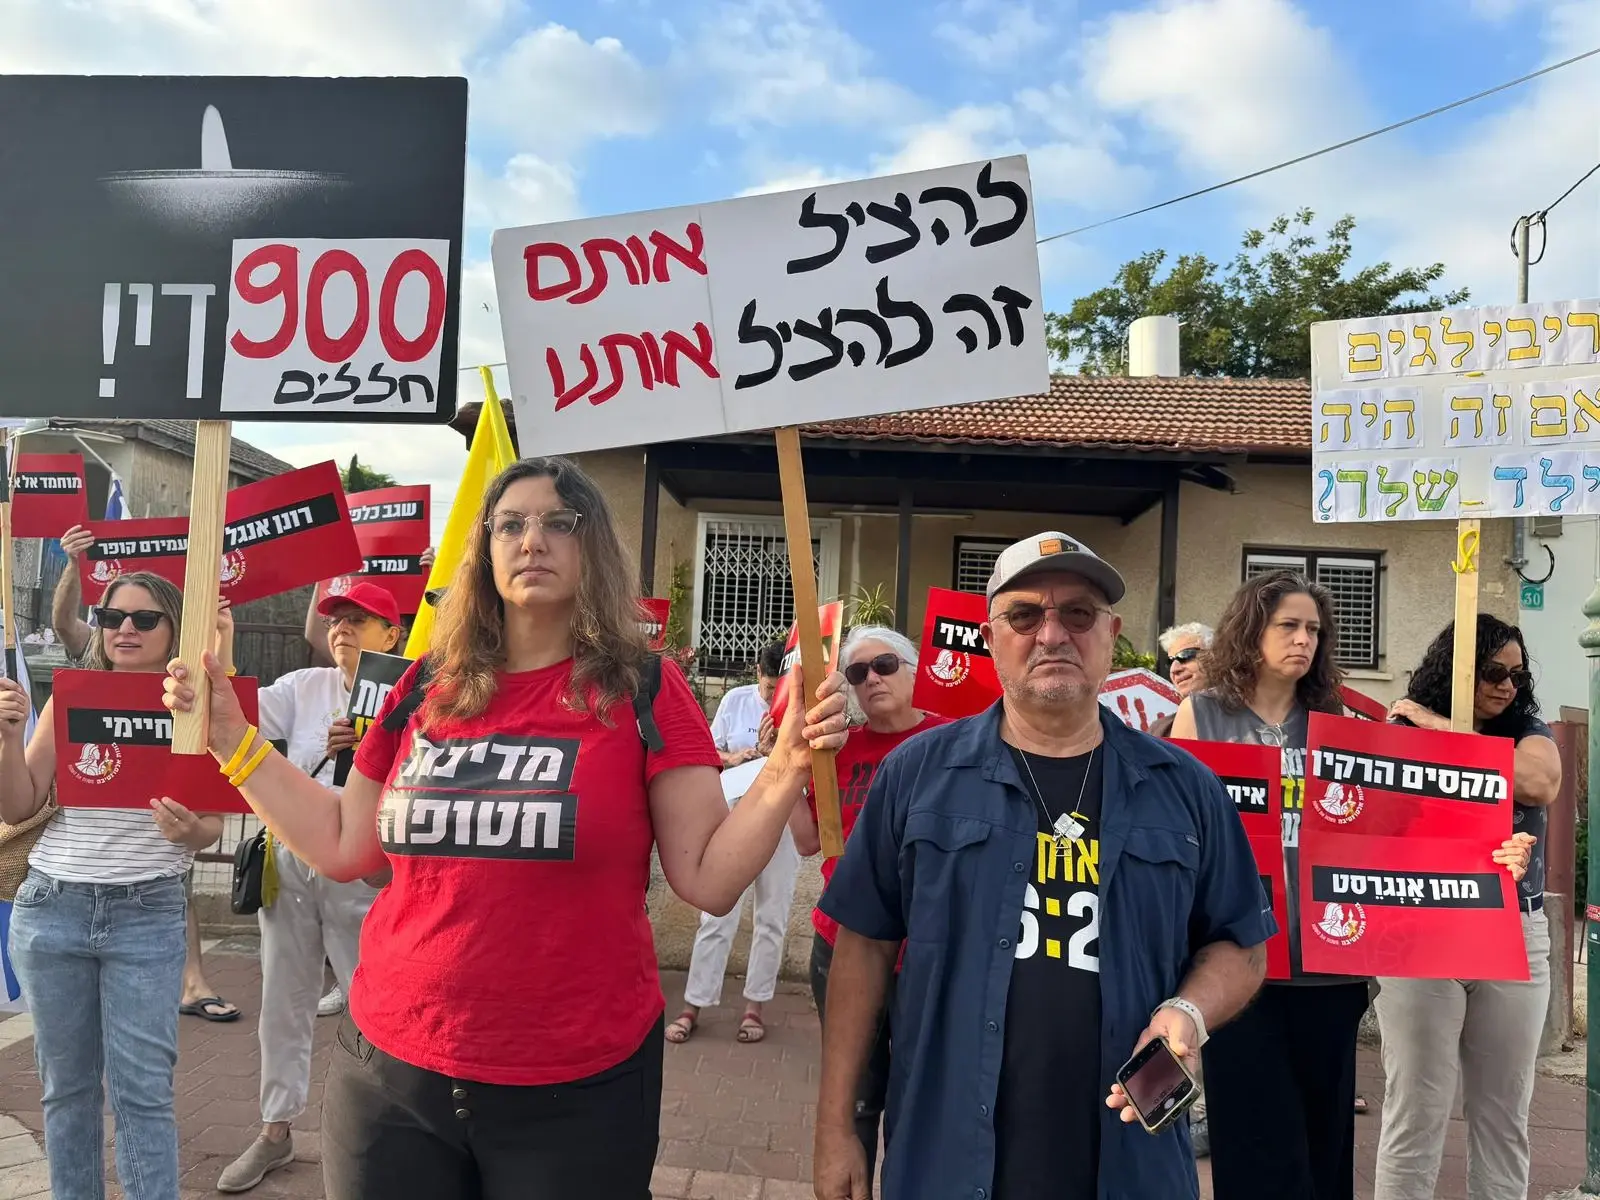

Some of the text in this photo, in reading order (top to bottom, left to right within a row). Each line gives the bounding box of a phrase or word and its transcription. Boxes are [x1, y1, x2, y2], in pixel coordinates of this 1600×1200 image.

[523, 161, 1028, 304] להציל אותם
[230, 243, 446, 363] 900
[545, 276, 1033, 411] זה להציל אותנו
[273, 363, 435, 404] חללים
[1320, 399, 1416, 443] היה
[1450, 394, 1512, 439] זה
[40, 476, 83, 489] מוחמד
[1493, 457, 1600, 511] ילד
[225, 506, 314, 546] רונן אנגל
[381, 502, 417, 518] שגב
[98, 538, 188, 555] עמירם קופר
[371, 559, 409, 572] עמרי
[102, 717, 173, 739] חיימי
[400, 739, 564, 782] מדינת
[1311, 749, 1508, 800] מקסים הרקין
[378, 798, 562, 849] חטופה
[1429, 878, 1480, 900] מתן
